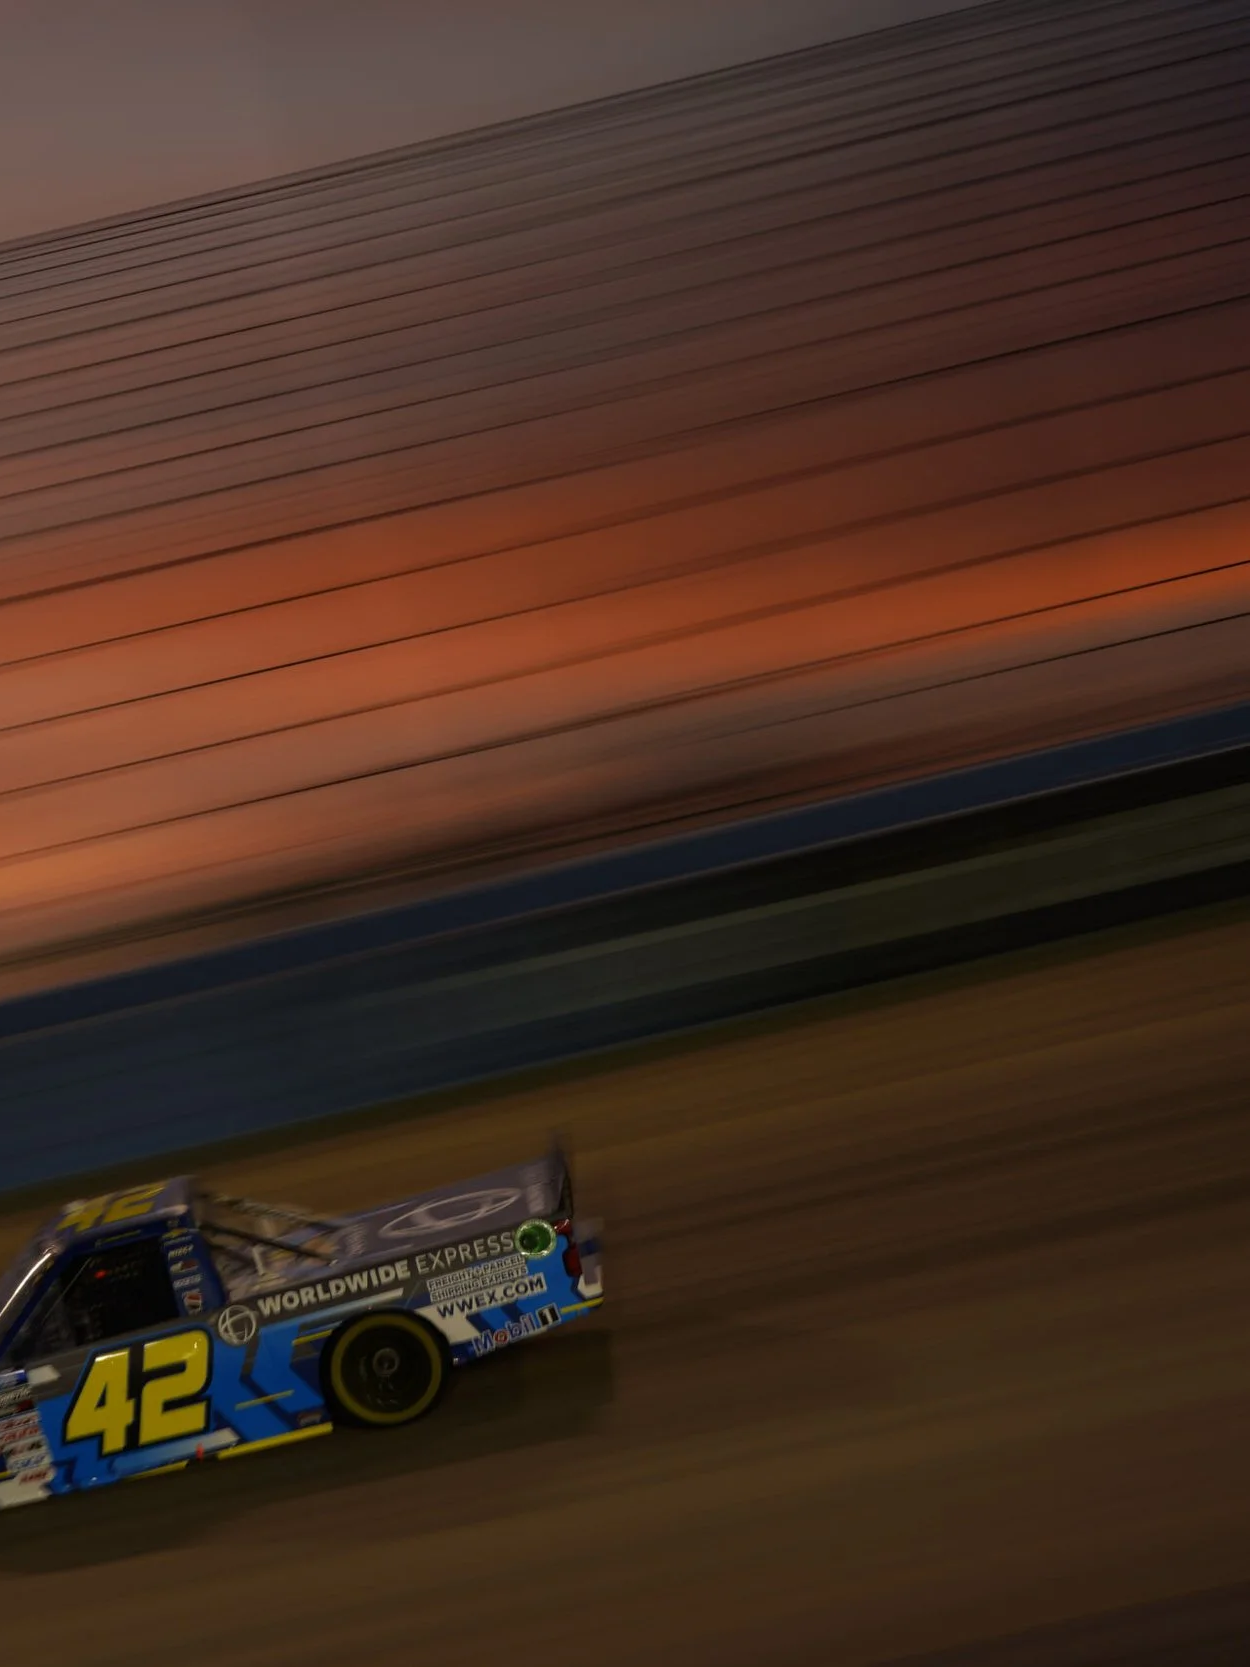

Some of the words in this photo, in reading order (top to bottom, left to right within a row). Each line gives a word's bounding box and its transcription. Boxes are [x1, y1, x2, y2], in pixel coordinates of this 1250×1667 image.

[56, 1182, 166, 1232] 42
[257, 1259, 411, 1318] WORLDWIDE
[415, 1231, 515, 1275] EXPRESS
[428, 1269, 472, 1291] FREIGHT
[483, 1256, 526, 1275] PARCEL
[431, 1280, 480, 1302] SHIPPING
[481, 1266, 528, 1288] EXPERTS
[437, 1277, 545, 1318] WWEX.COM
[472, 1314, 537, 1357] Mobil
[64, 1329, 211, 1457] 42
